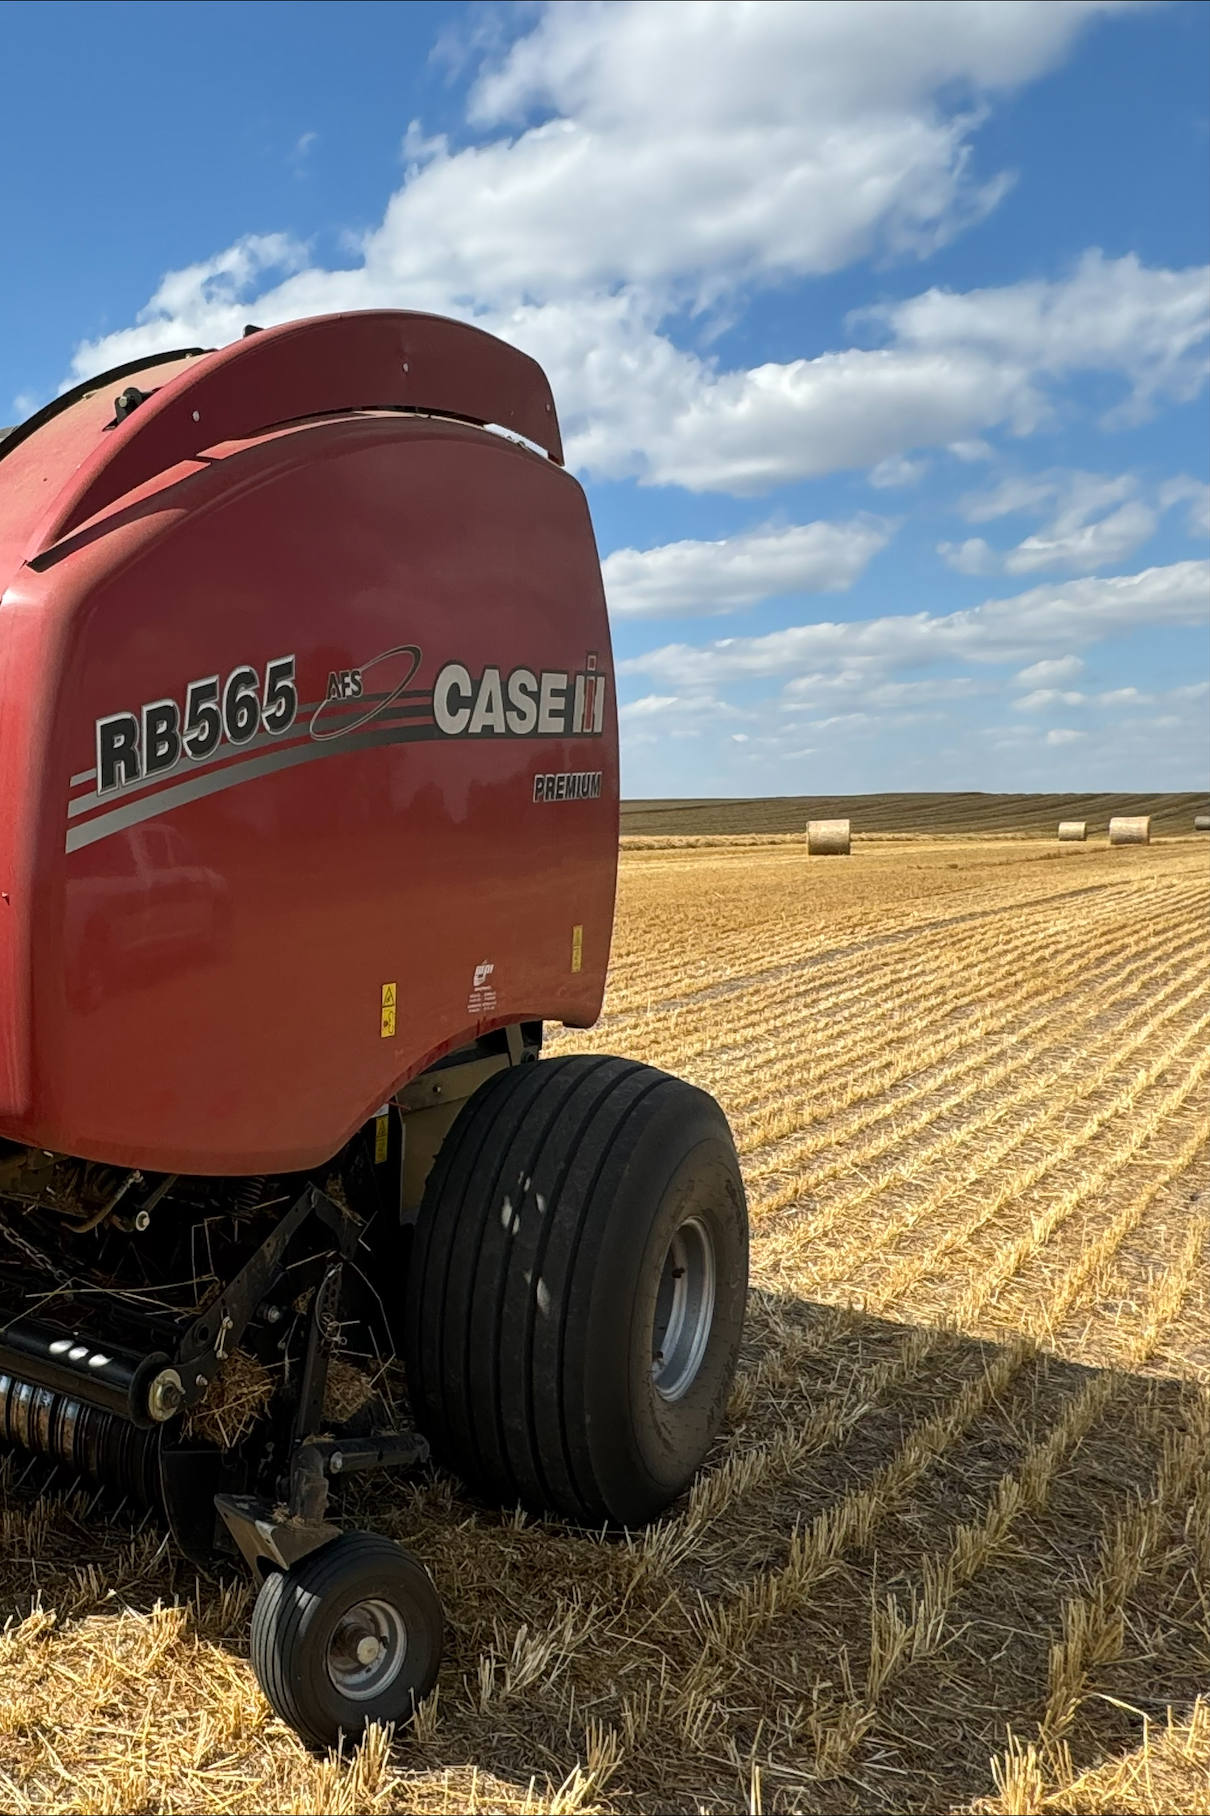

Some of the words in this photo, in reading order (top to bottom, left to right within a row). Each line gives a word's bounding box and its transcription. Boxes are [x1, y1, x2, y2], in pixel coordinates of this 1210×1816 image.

[326, 668, 363, 701] AFS
[433, 663, 568, 735] CASE
[96, 654, 298, 796] RB565
[533, 771, 602, 803] PREMIUM
